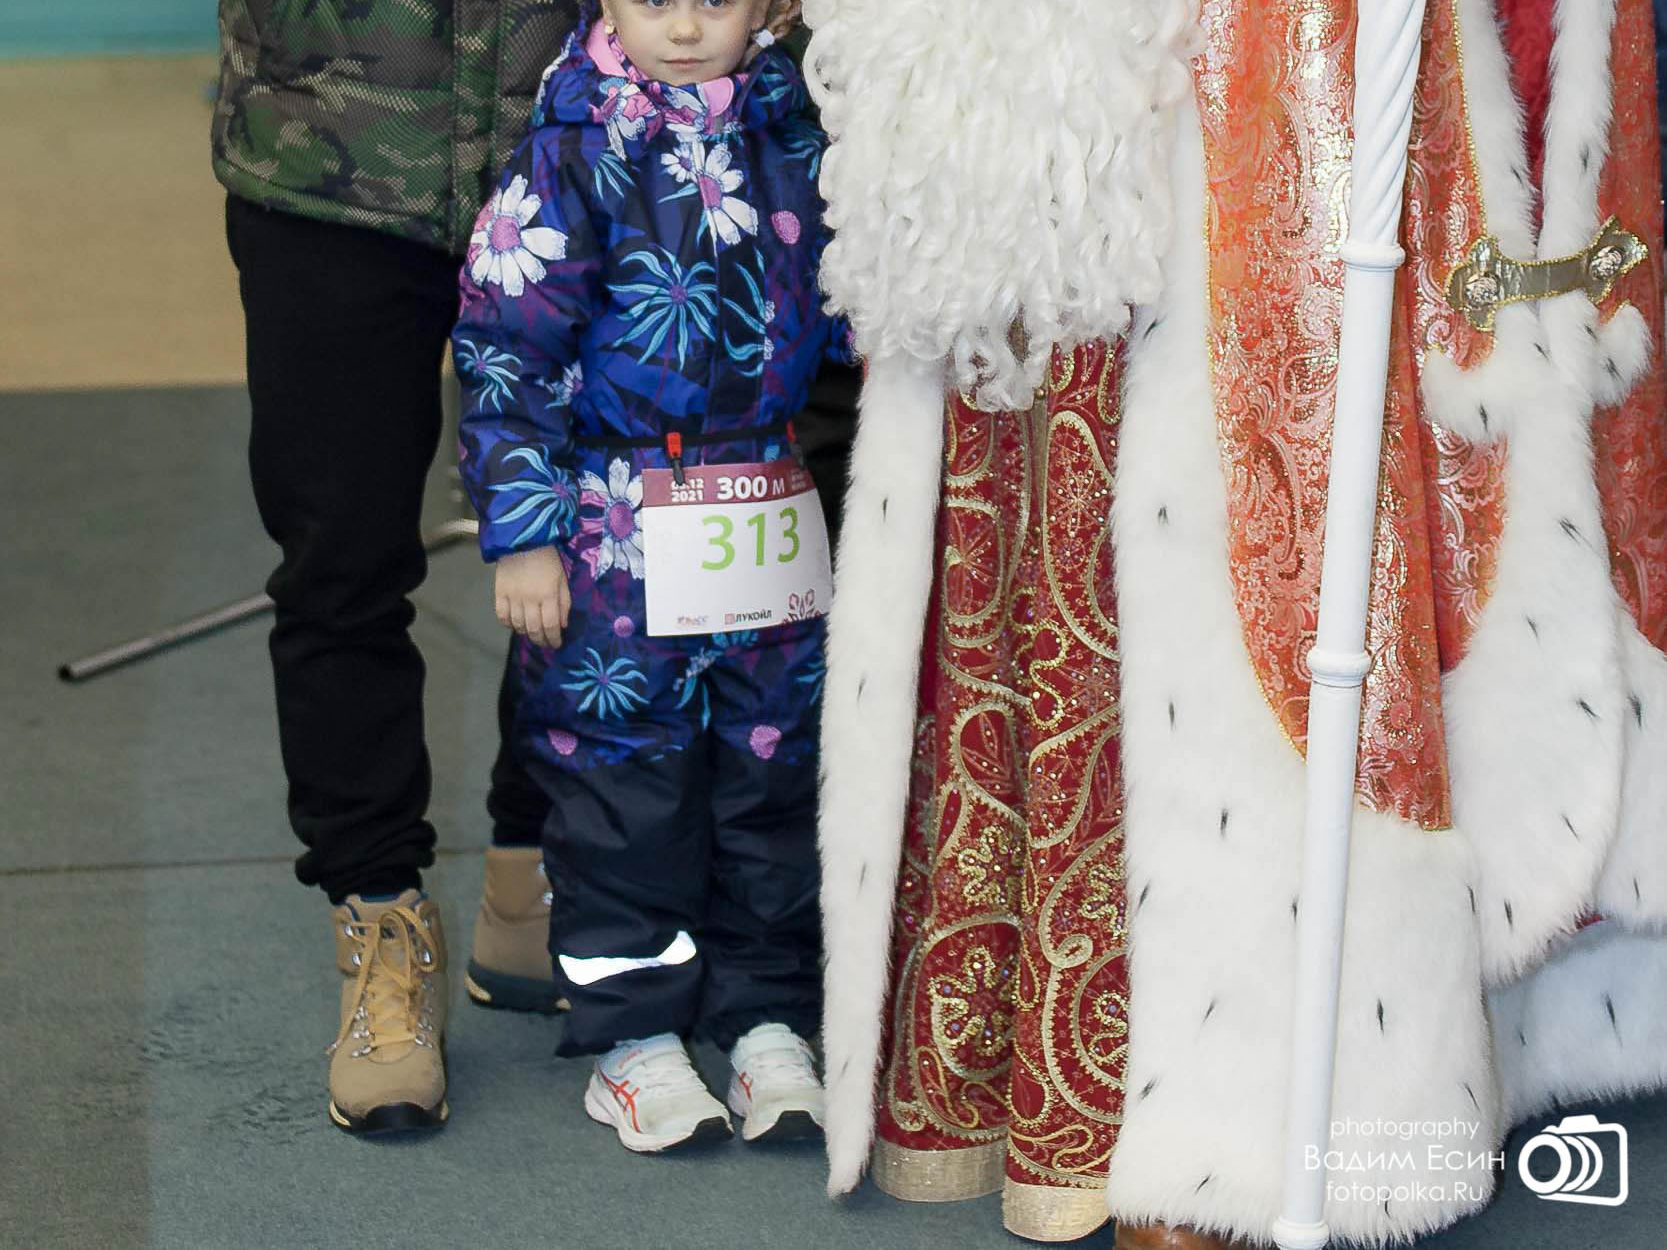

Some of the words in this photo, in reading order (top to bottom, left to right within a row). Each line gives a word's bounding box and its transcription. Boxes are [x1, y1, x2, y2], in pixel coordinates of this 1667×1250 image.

[671, 490, 704, 502] 2021
[716, 475, 768, 500] 300
[772, 477, 785, 495] М
[701, 507, 801, 570] 313
[735, 609, 773, 623] ЛУКОЙЛ
